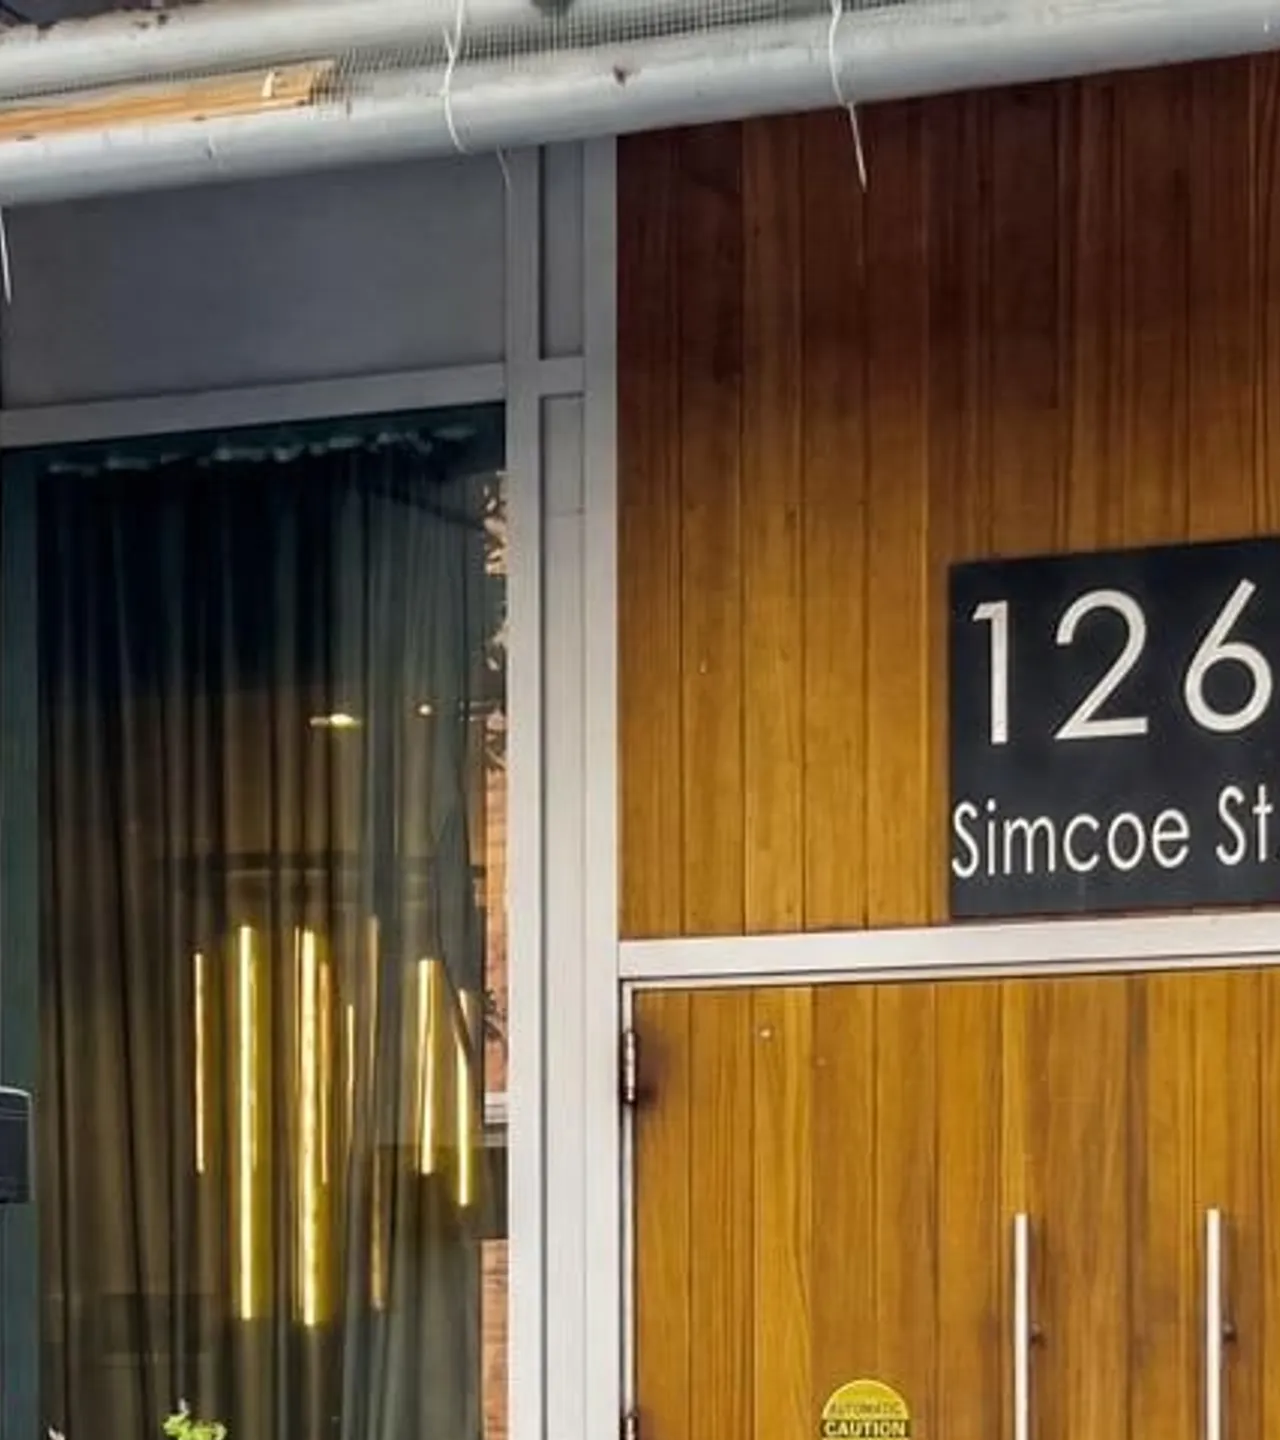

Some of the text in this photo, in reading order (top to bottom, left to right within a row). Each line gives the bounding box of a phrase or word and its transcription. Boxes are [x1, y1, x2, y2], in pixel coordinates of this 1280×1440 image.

[972, 578, 1273, 745] 126
[952, 799, 1191, 878] Simcoe
[824, 1421, 906, 1436] CAUTION
